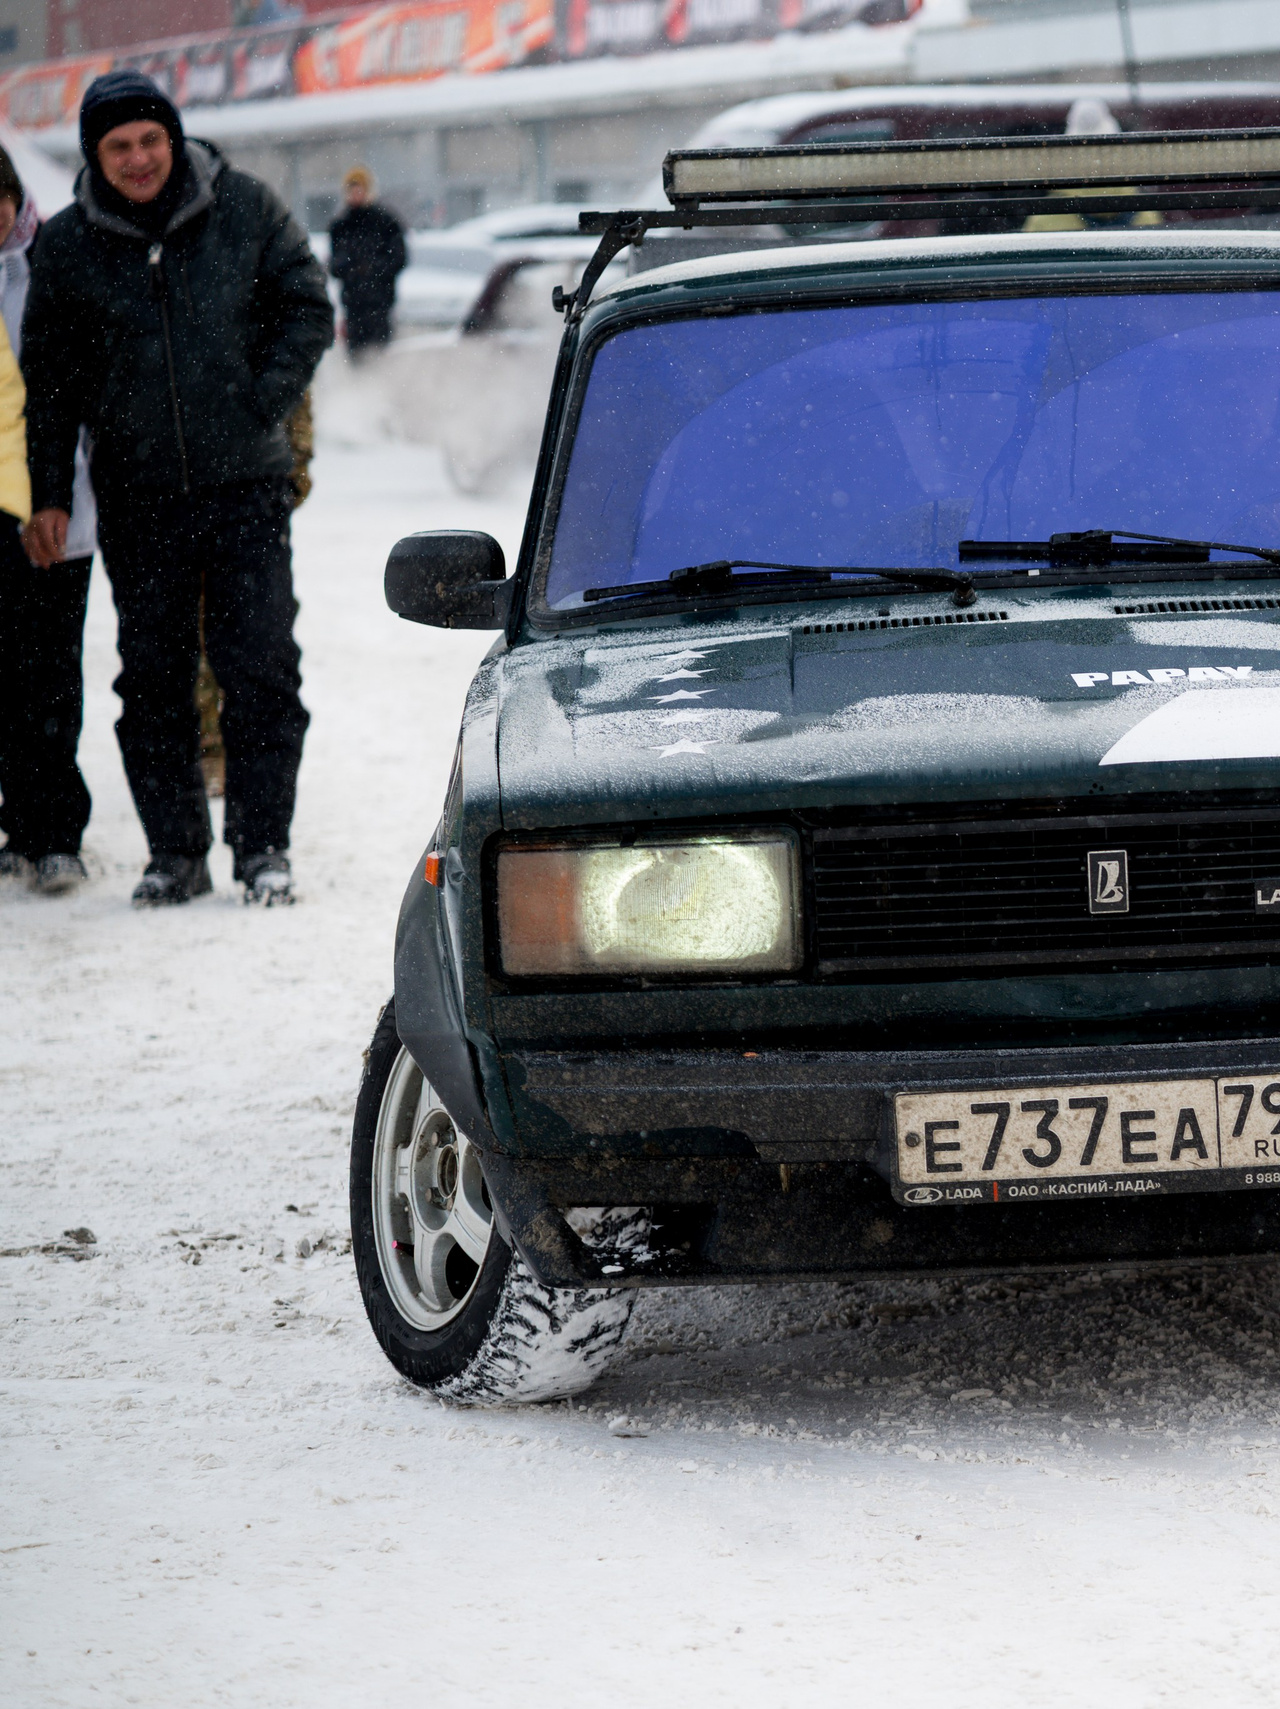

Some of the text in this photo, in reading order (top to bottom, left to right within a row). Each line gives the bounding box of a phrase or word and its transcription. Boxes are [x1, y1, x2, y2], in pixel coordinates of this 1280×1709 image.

[1071, 667, 1252, 687] PAPAY
[1245, 1173, 1253, 1184] 8
[1256, 1172, 1280, 1183] 988
[945, 1187, 983, 1200] LADA
[1008, 1179, 1162, 1197] ОАО «КАСПИЙ-ЛАДА»
